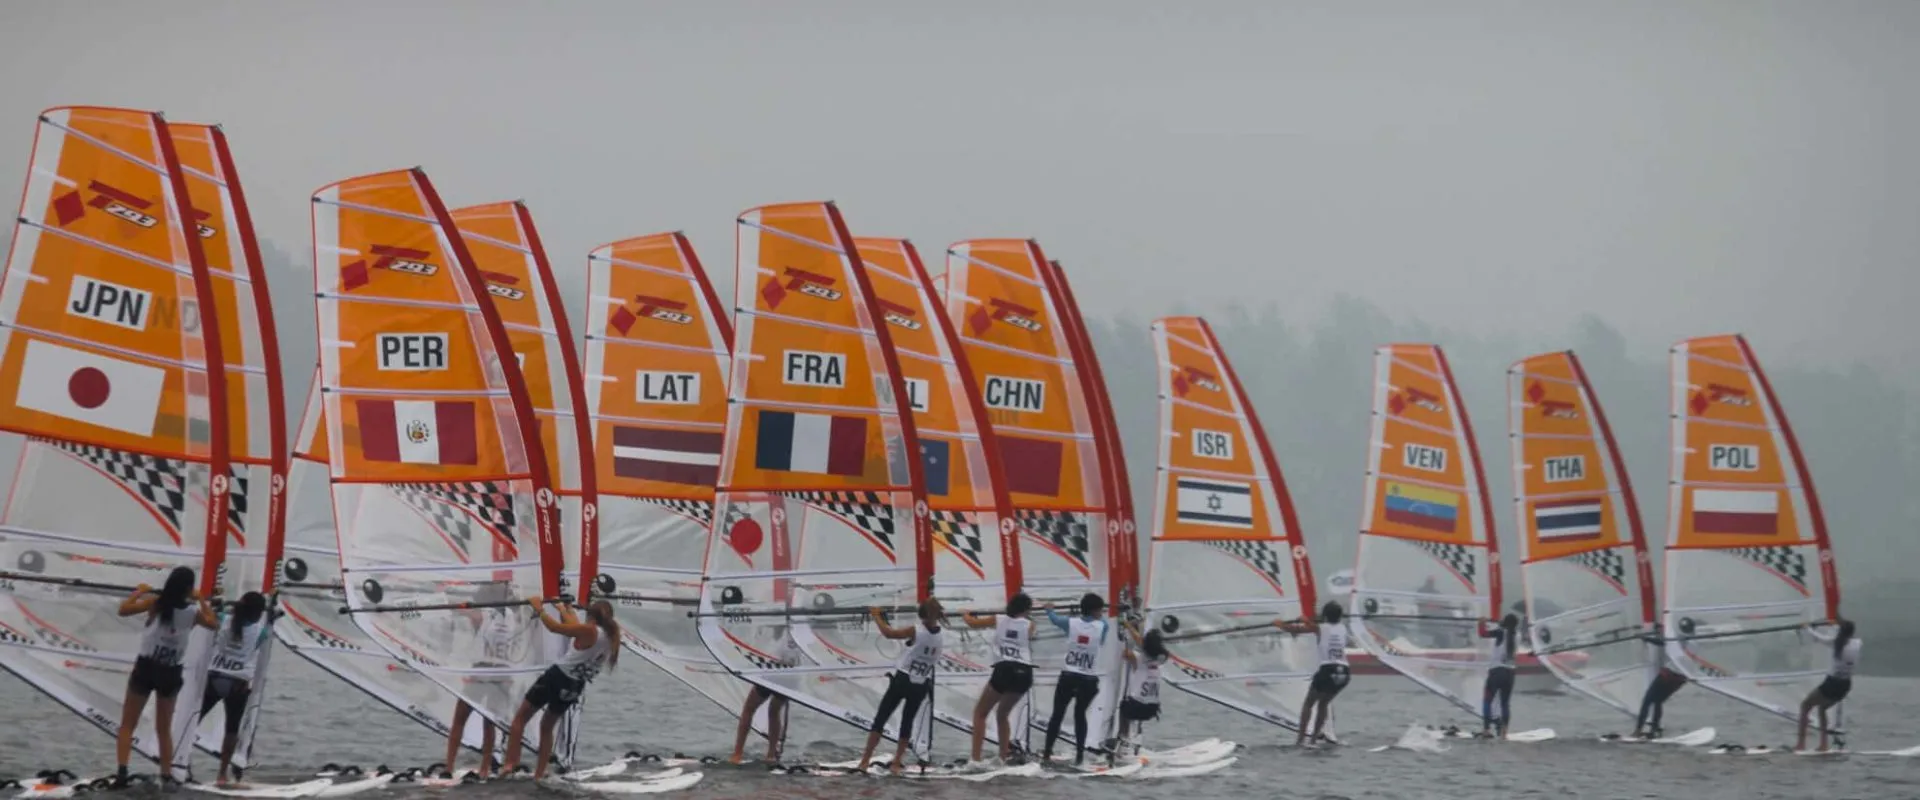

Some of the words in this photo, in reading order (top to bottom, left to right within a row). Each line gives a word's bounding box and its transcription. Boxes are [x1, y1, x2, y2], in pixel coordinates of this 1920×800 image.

[72, 281, 144, 326] JPN
[153, 296, 200, 333] ND
[381, 335, 444, 367] PER
[787, 352, 842, 385] FRA
[643, 373, 694, 402] LAT
[986, 378, 1042, 410] CHN
[1196, 431, 1228, 456] ISR
[1406, 444, 1444, 470] VEN
[1712, 446, 1757, 469] POL
[1545, 458, 1584, 480] THA
[1065, 651, 1095, 669] CHN
